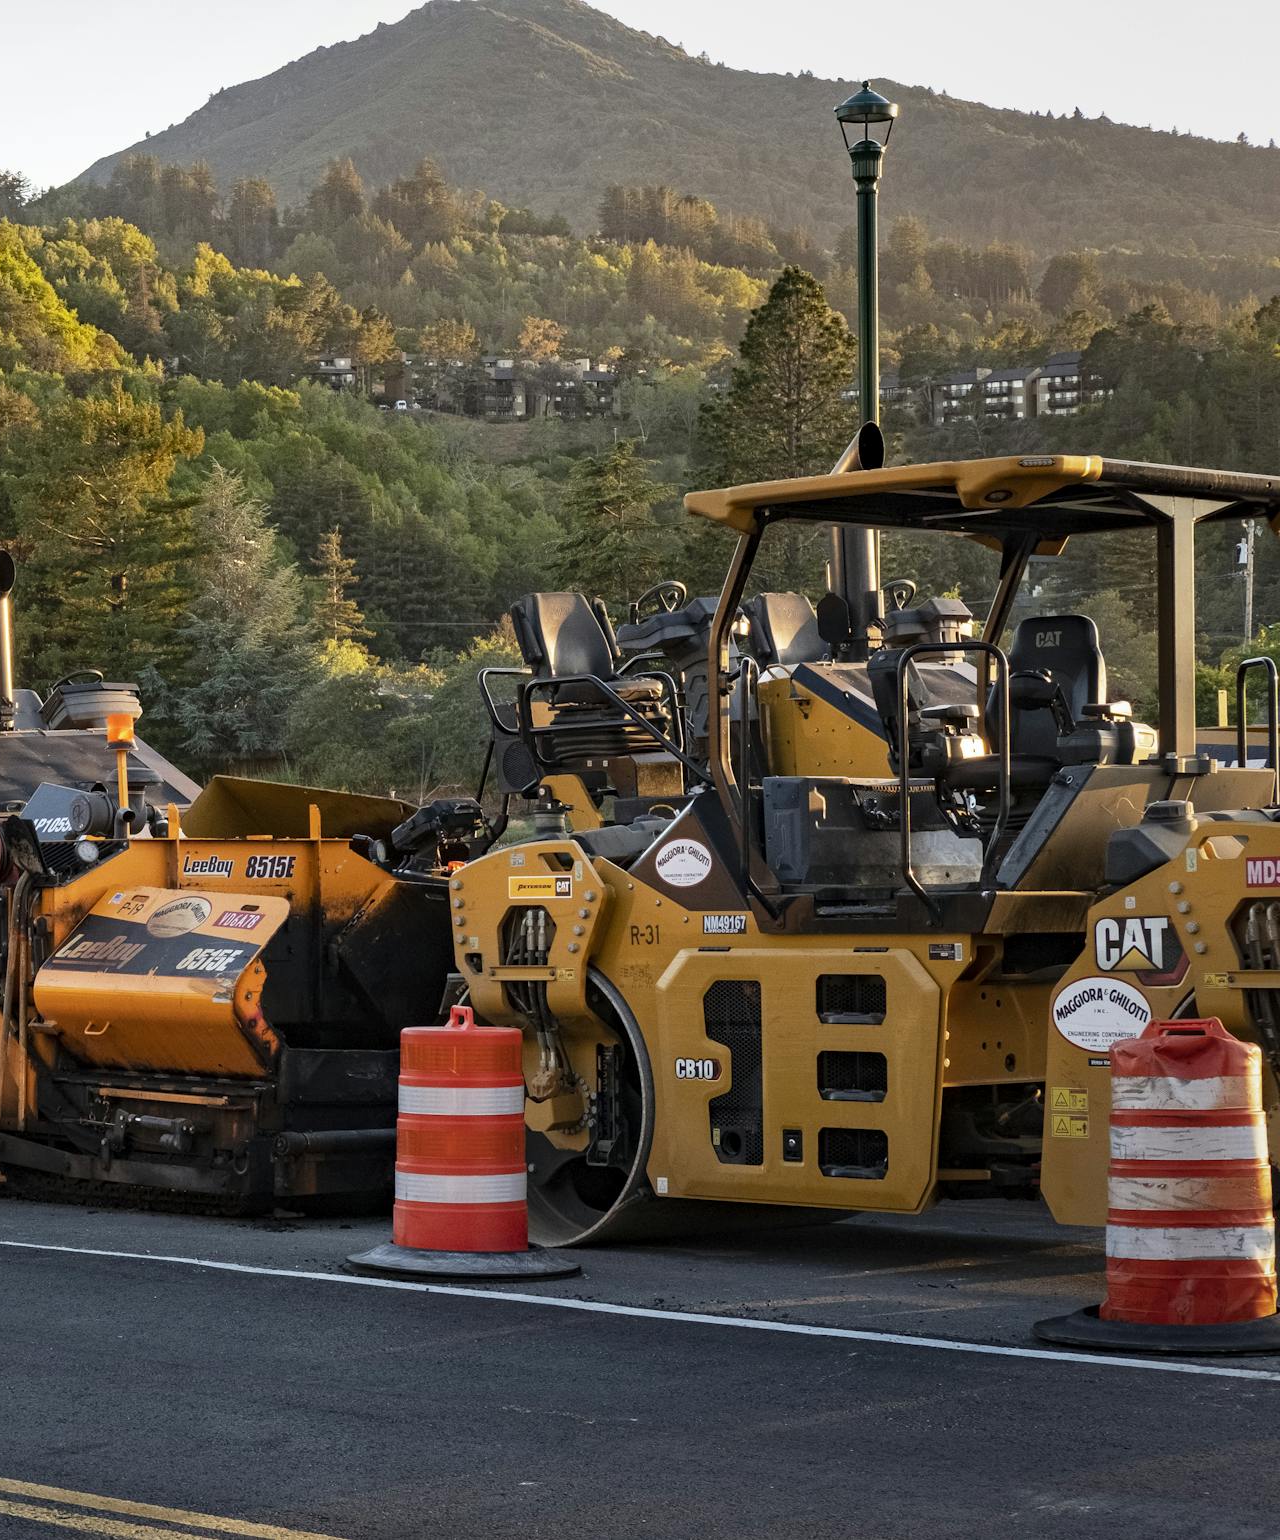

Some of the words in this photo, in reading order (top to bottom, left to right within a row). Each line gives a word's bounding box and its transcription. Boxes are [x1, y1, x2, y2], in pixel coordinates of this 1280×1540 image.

[1035, 631, 1063, 648] CAT
[33, 817, 73, 833] P1055
[183, 856, 234, 878] LeeBoy
[245, 855, 297, 878] 8515E
[657, 846, 685, 868] MAGGIORA
[688, 847, 710, 867] GHILOTTI
[1247, 860, 1280, 884] MD
[556, 881, 570, 893] CAT
[117, 903, 145, 915] P-19
[704, 915, 747, 930] NM49167
[631, 924, 660, 945] R-31
[1095, 917, 1169, 971] CAT
[54, 933, 148, 970] LeeBoy
[176, 948, 245, 972] 8515E
[1056, 988, 1103, 1021] MAGGIORA
[1109, 989, 1149, 1023] GHILOTTI
[675, 1058, 714, 1080] CB10
